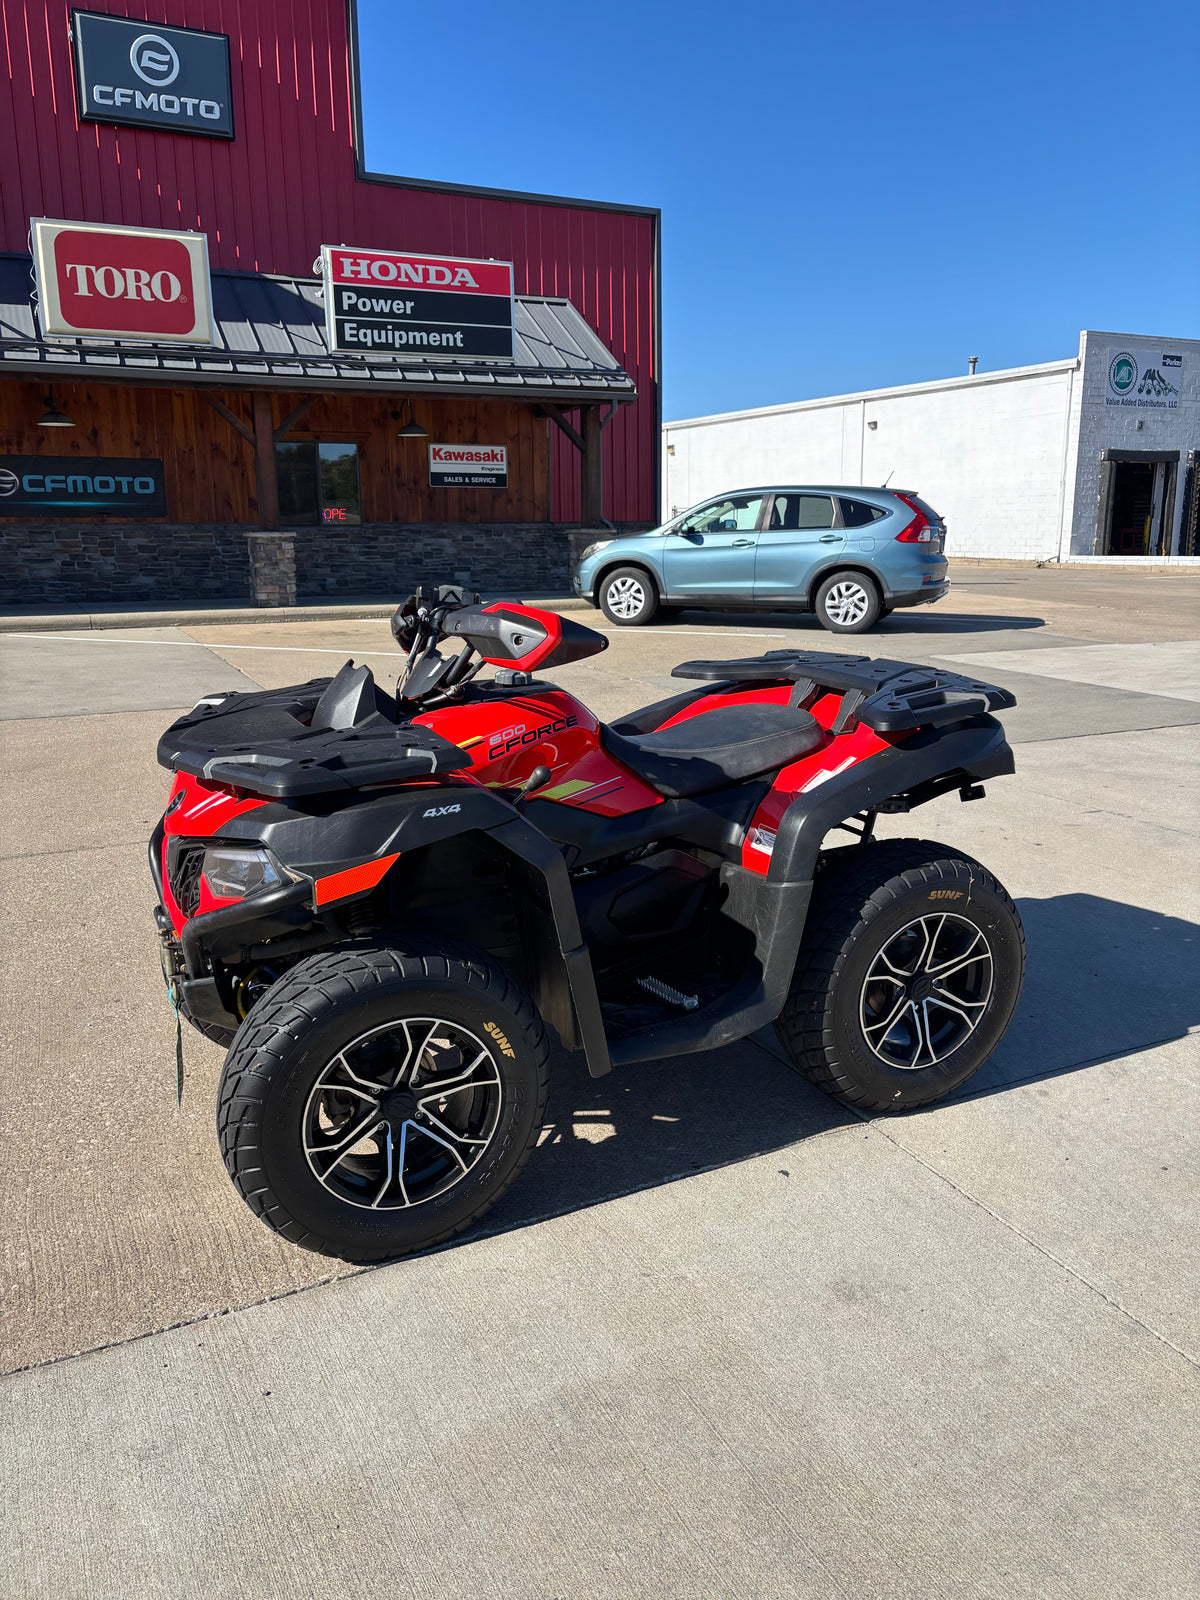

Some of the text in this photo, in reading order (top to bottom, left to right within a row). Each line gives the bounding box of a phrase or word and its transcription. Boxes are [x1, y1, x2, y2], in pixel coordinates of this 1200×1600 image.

[93, 84, 221, 120] CFMOTO
[65, 263, 182, 303] TORO
[339, 257, 480, 288] HONDA
[341, 291, 415, 315] Power
[343, 322, 464, 348] Equipment
[1105, 397, 1120, 406] Value
[1121, 398, 1137, 407] Added
[1168, 400, 1178, 409] LLC
[432, 447, 504, 462] Kawasaki
[22, 474, 156, 494] CFMOTO
[488, 715, 578, 761] CFORCE
[489, 723, 526, 746] 600
[928, 890, 964, 900] SUNF
[482, 1021, 515, 1060] SUNF
